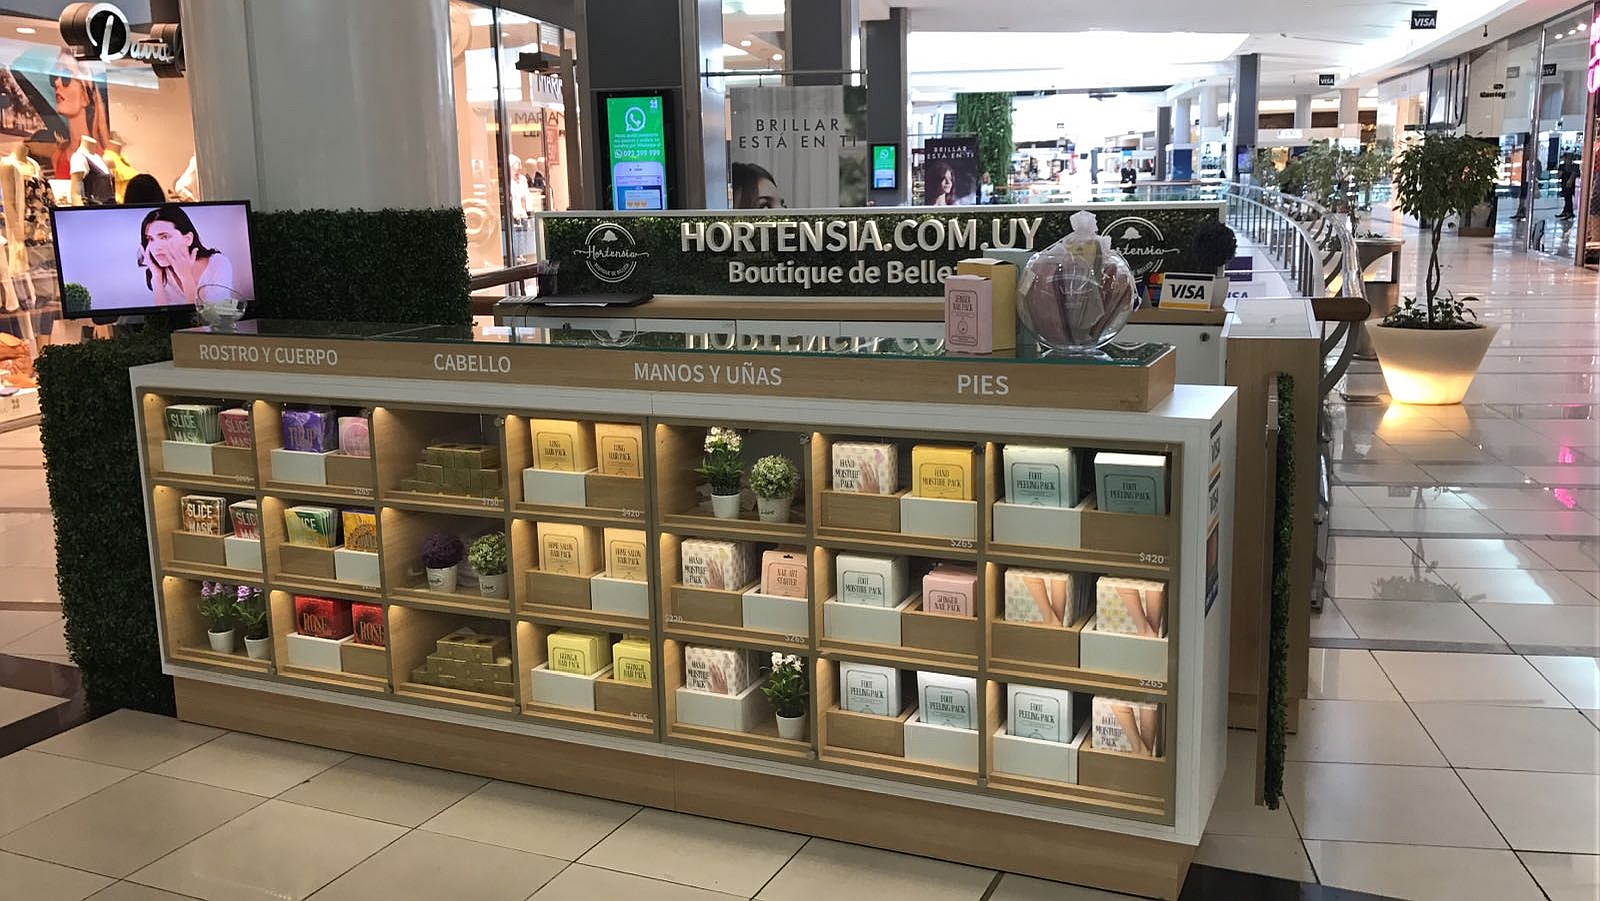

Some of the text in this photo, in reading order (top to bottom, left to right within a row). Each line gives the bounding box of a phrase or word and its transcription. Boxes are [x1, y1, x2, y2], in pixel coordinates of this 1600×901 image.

[1413, 17, 1435, 27] VISA
[756, 118, 839, 131] BRILLAR
[739, 132, 856, 148] ESTÁ EN TI
[680, 217, 1043, 253] HORTENSIA.COM.UY
[573, 244, 650, 260] Hortensia
[1116, 243, 1180, 255] tensia
[728, 259, 957, 290] Boutique de Belle
[1170, 284, 1205, 300] VISA
[199, 344, 339, 366] ROSTRO Y CUERPO
[433, 352, 511, 374] CABELLO
[634, 361, 782, 386] MANOS Y UÑAS
[957, 374, 1009, 396] PIES
[171, 413, 196, 429] SLICE
[231, 437, 251, 448] MAS
[840, 479, 855, 489] PACK
[187, 503, 213, 519] SLICE
[235, 510, 257, 526] SLIC
[951, 539, 973, 549] $265
[1139, 552, 1165, 564] $420
[868, 586, 882, 595] PACK
[1139, 678, 1163, 688] $265
[871, 690, 884, 699] PACK
[951, 704, 966, 713] PACK
[1040, 714, 1055, 724] PACK
